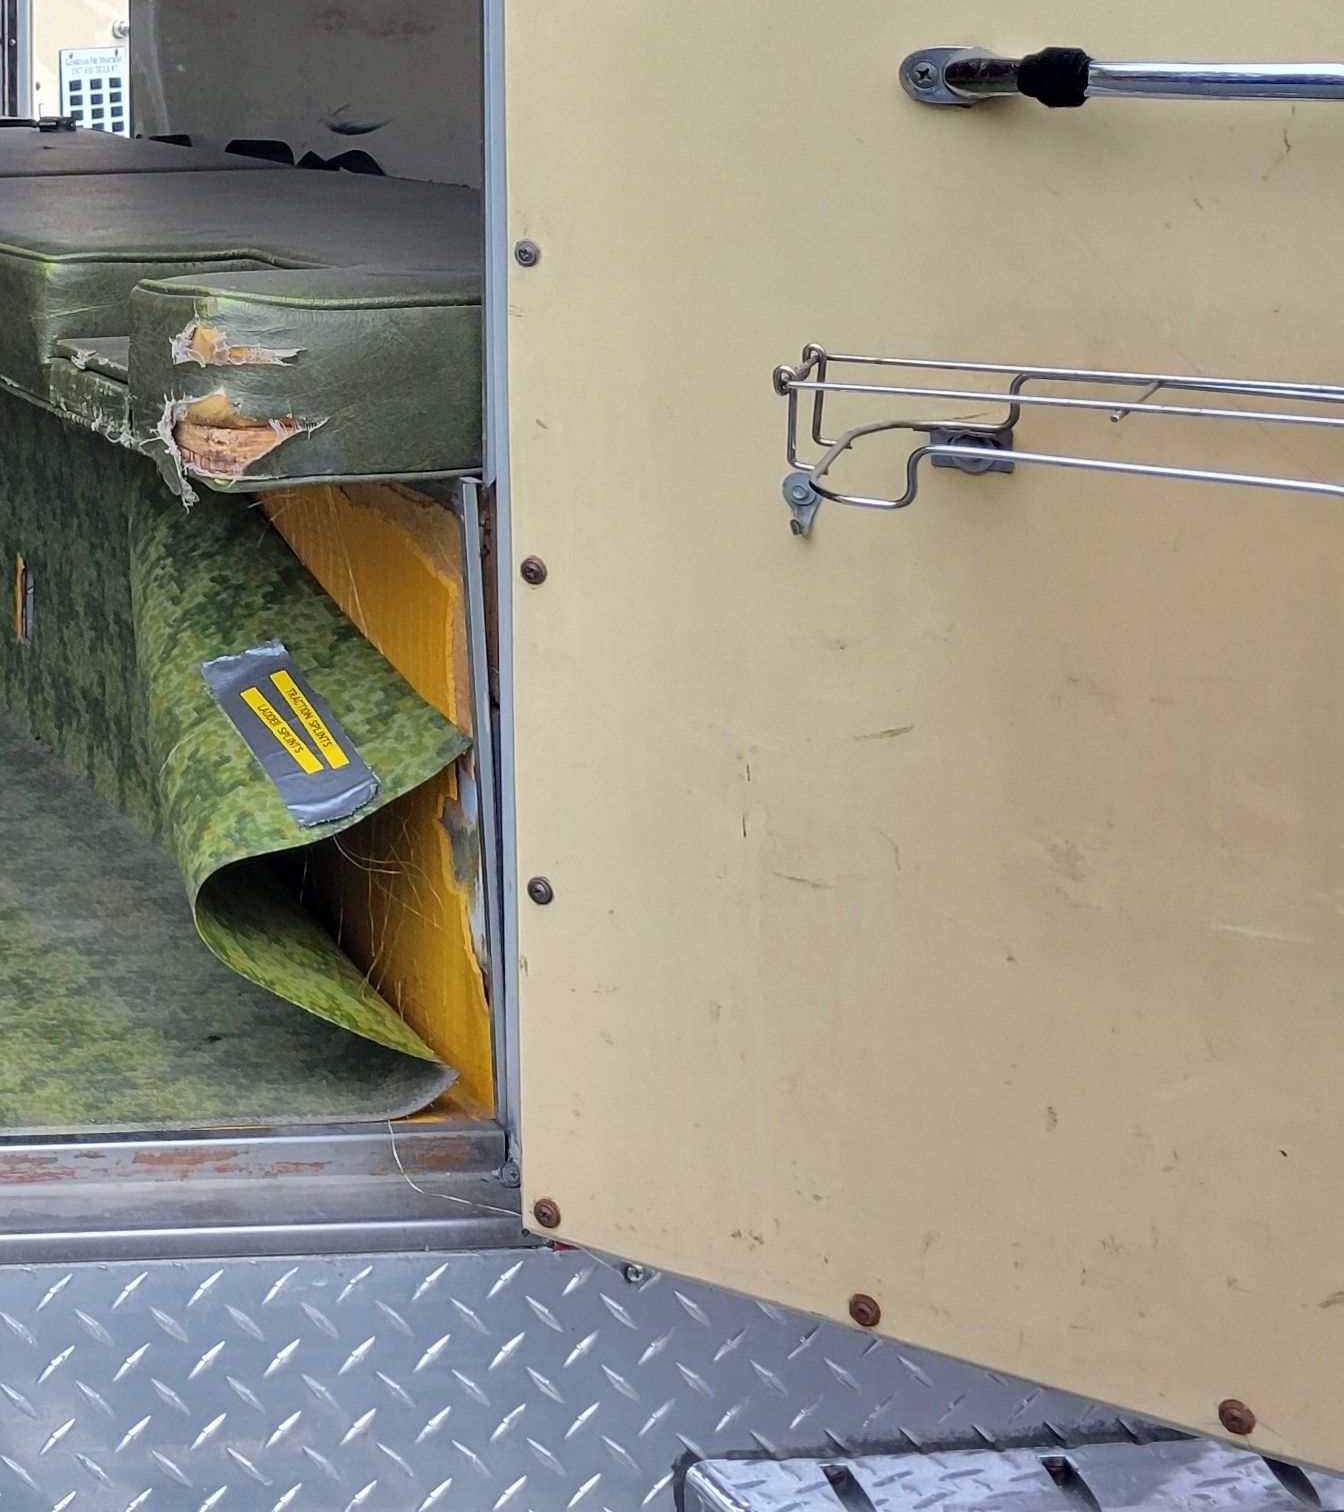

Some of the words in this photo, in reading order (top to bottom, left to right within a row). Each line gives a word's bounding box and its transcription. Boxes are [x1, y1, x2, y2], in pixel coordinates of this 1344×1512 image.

[257, 704, 282, 727] LADDER
[277, 727, 304, 754] SPLINTS
[286, 688, 314, 720] TRACTION
[308, 719, 333, 748] SPLINTS
